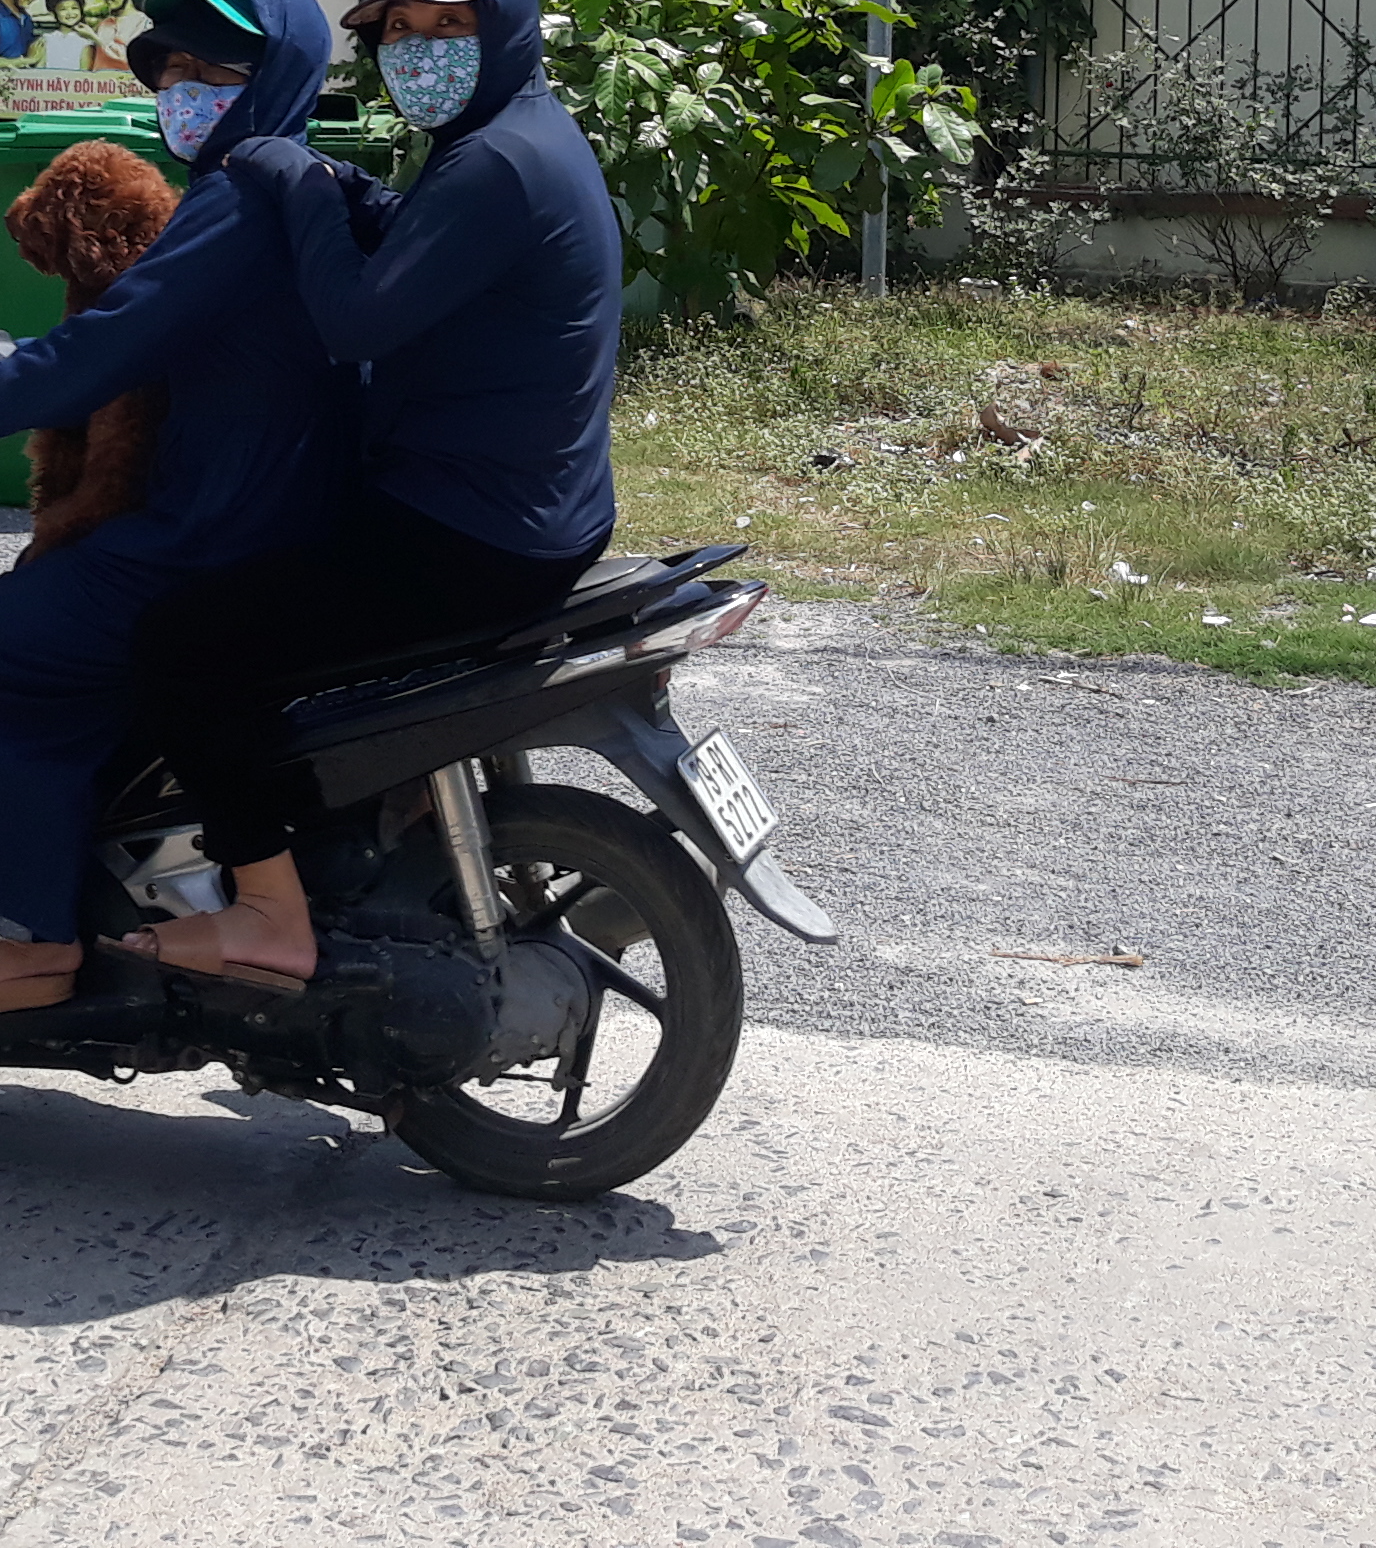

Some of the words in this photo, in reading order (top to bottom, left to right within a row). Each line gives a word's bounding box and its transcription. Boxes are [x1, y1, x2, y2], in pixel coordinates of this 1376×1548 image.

[46, 77, 71, 93] HÃY
[74, 78, 93, 95] ĐỘI
[97, 79, 116, 94] MŨ
[44, 98, 74, 111] TRÊN
[717, 784, 769, 847] 5272
